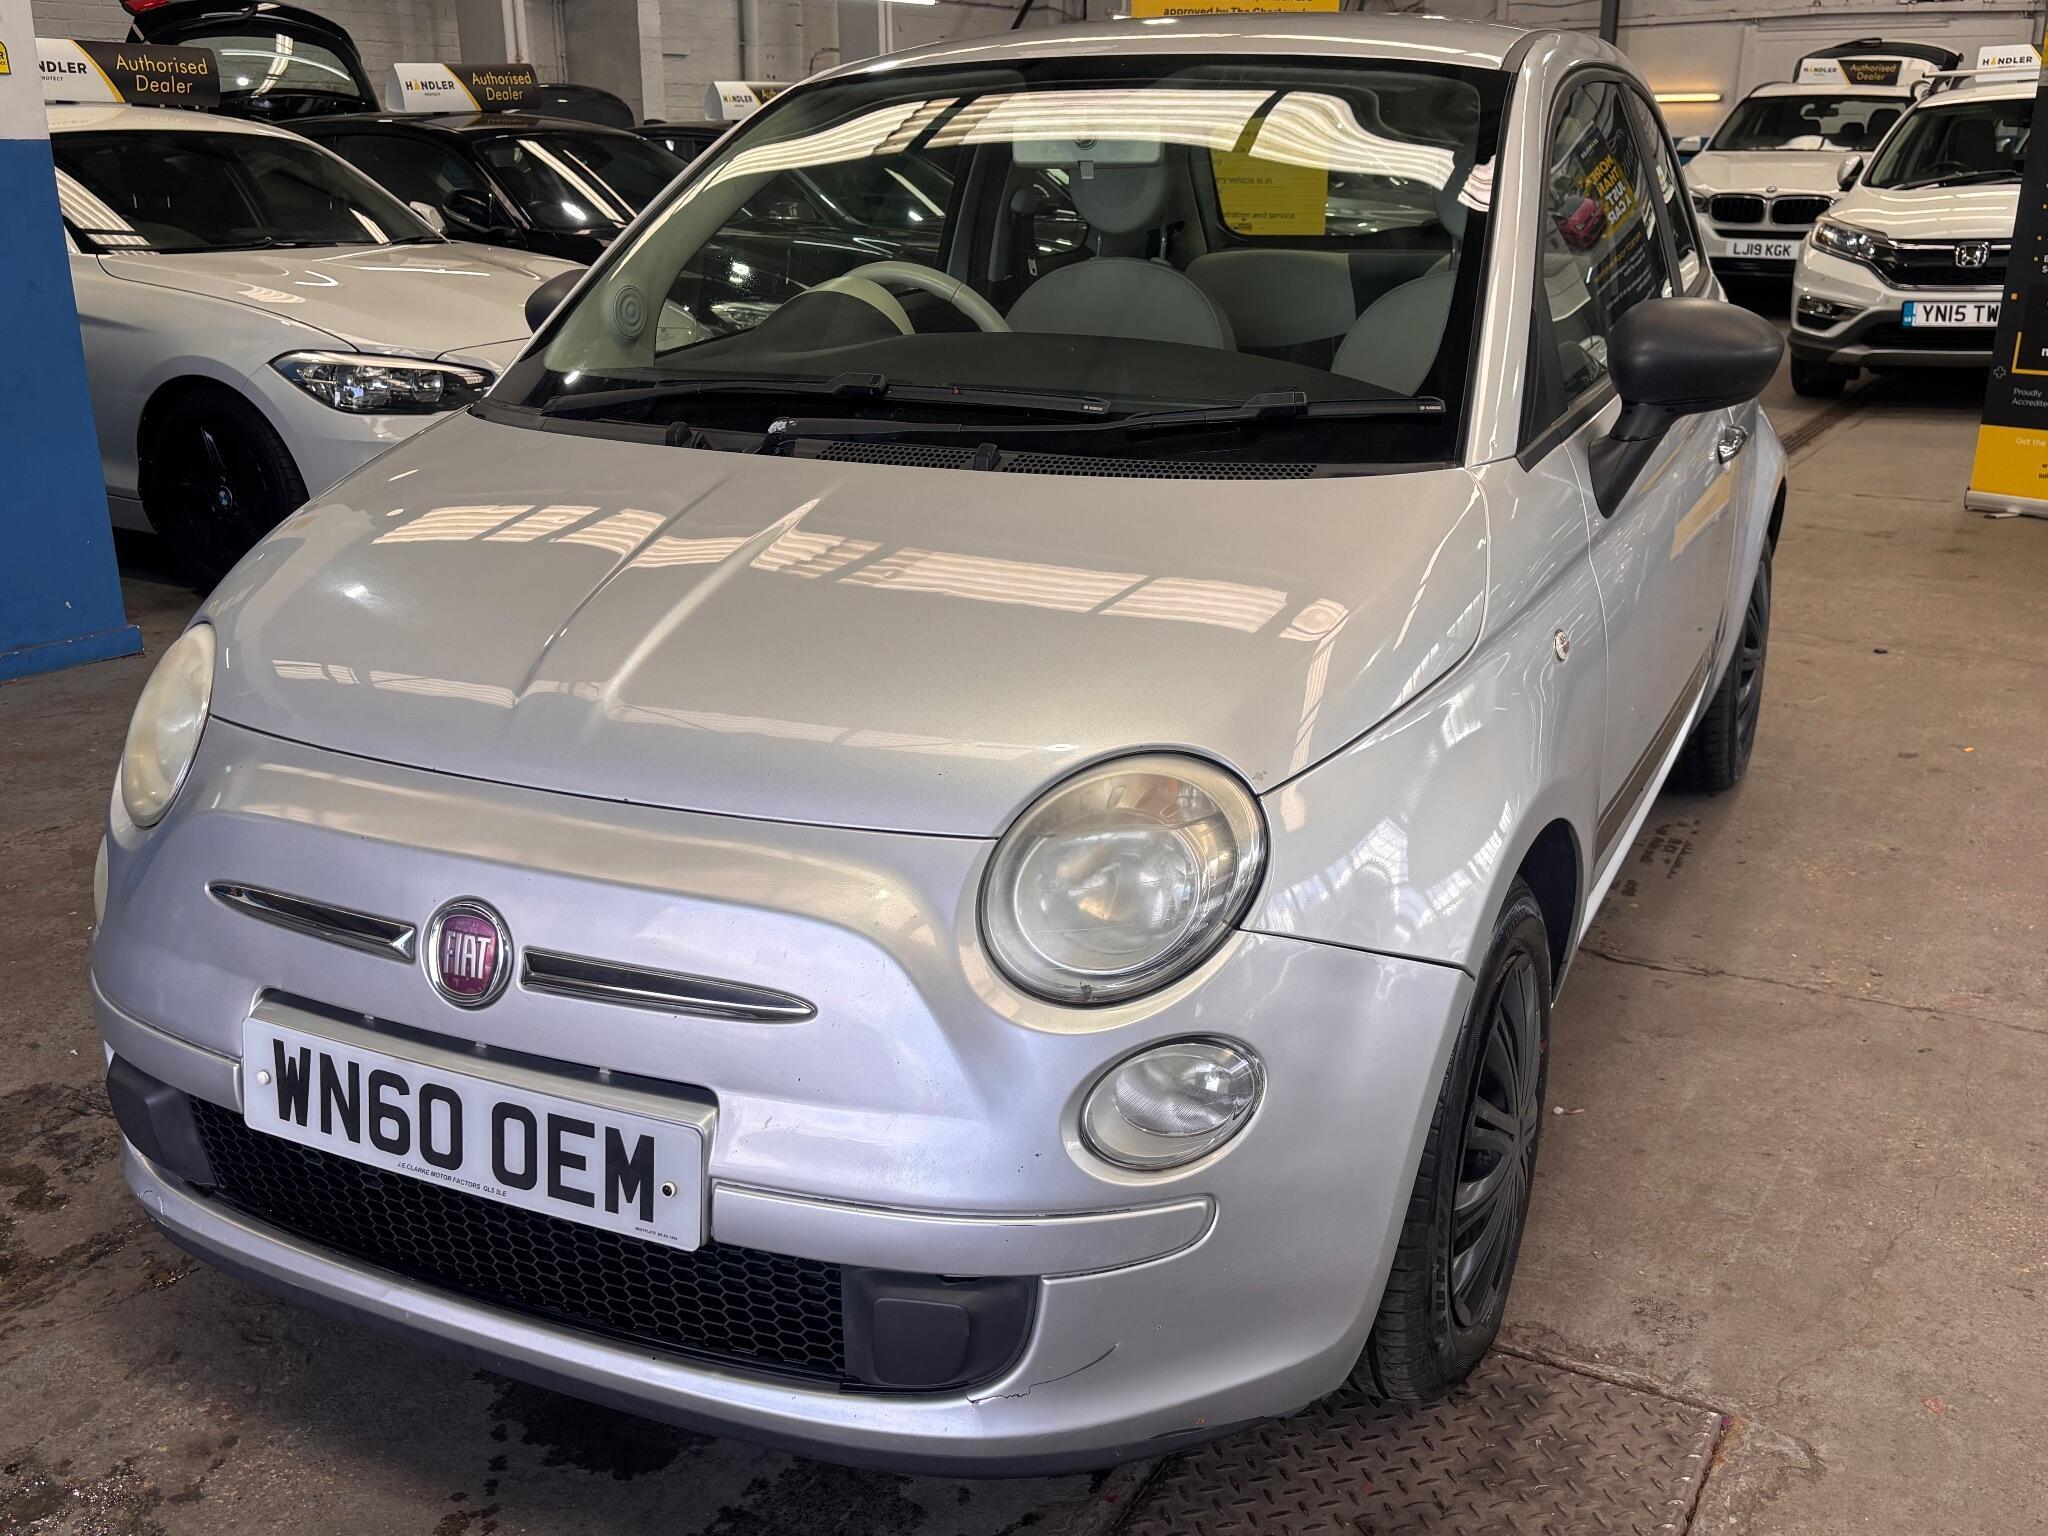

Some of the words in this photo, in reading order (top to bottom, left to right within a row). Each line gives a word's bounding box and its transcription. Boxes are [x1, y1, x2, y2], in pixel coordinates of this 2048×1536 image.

[39, 61, 87, 74] NDLER
[116, 54, 208, 75] Authorised
[1850, 64, 1897, 74] Authorised
[472, 71, 532, 85] Authorised
[1856, 71, 1886, 81] Dealer
[136, 75, 193, 94] Dealer
[486, 87, 524, 101] Dealer
[1733, 242, 1762, 256] LJ19
[1764, 243, 1792, 257] KGK
[1923, 304, 1967, 322] YN15
[1973, 304, 2000, 322] TW
[2013, 387, 2043, 398] Proudly
[2011, 397, 2048, 407] Accredite
[2015, 437, 2030, 446] Get
[2032, 438, 2047, 447] the
[443, 930, 491, 979] FIAT
[272, 1038, 463, 1171] WN60
[491, 1101, 655, 1223] OEM
[430, 1171, 452, 1182] MOTOR
[452, 1176, 481, 1190] FACTORS
